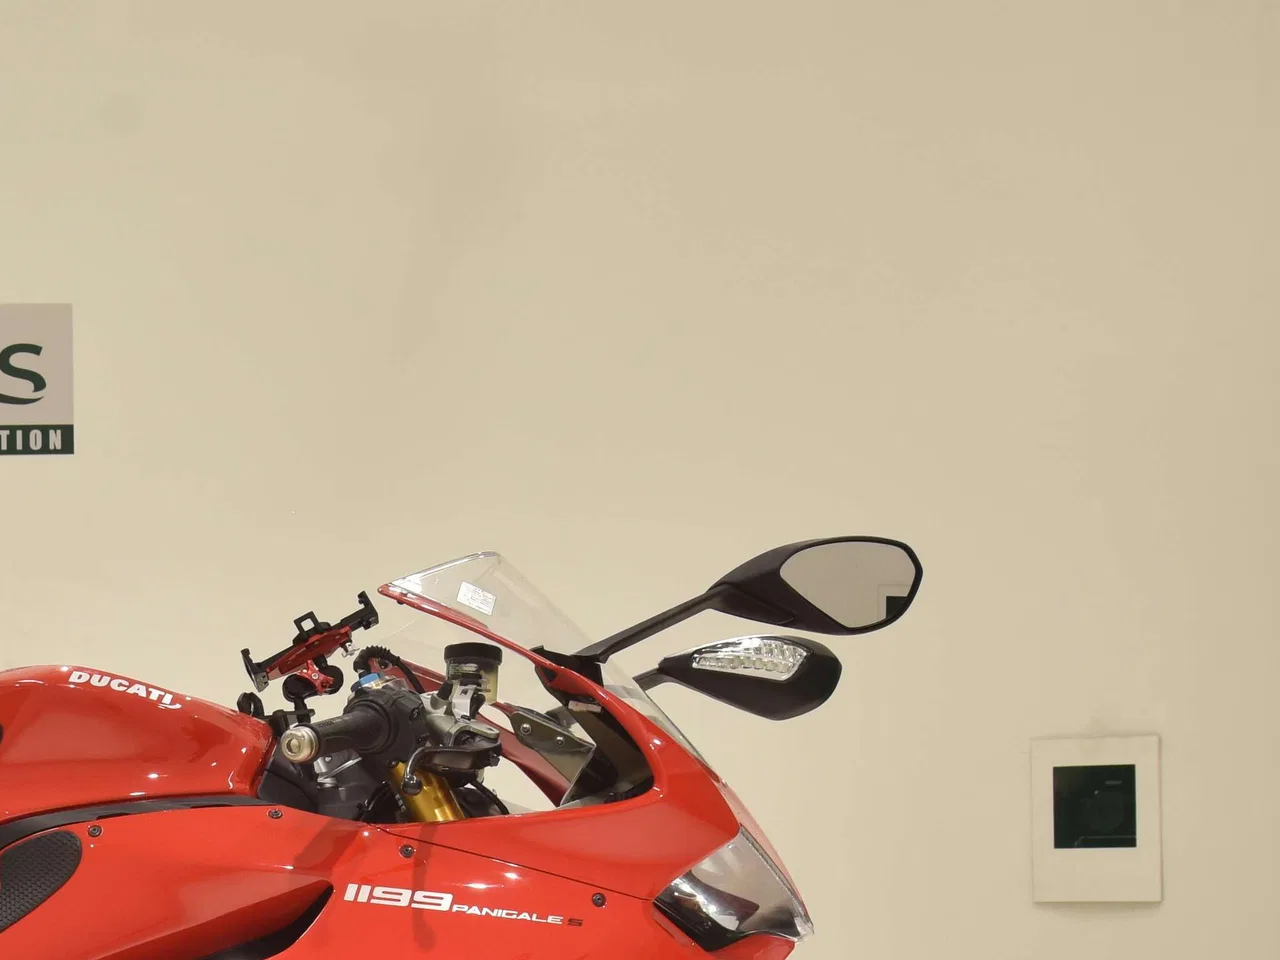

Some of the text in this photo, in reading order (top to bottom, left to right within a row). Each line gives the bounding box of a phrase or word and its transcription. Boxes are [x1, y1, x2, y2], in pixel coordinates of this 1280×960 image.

[68, 671, 174, 705] DUCATI
[343, 883, 584, 927] 1199 PANIGALE S
